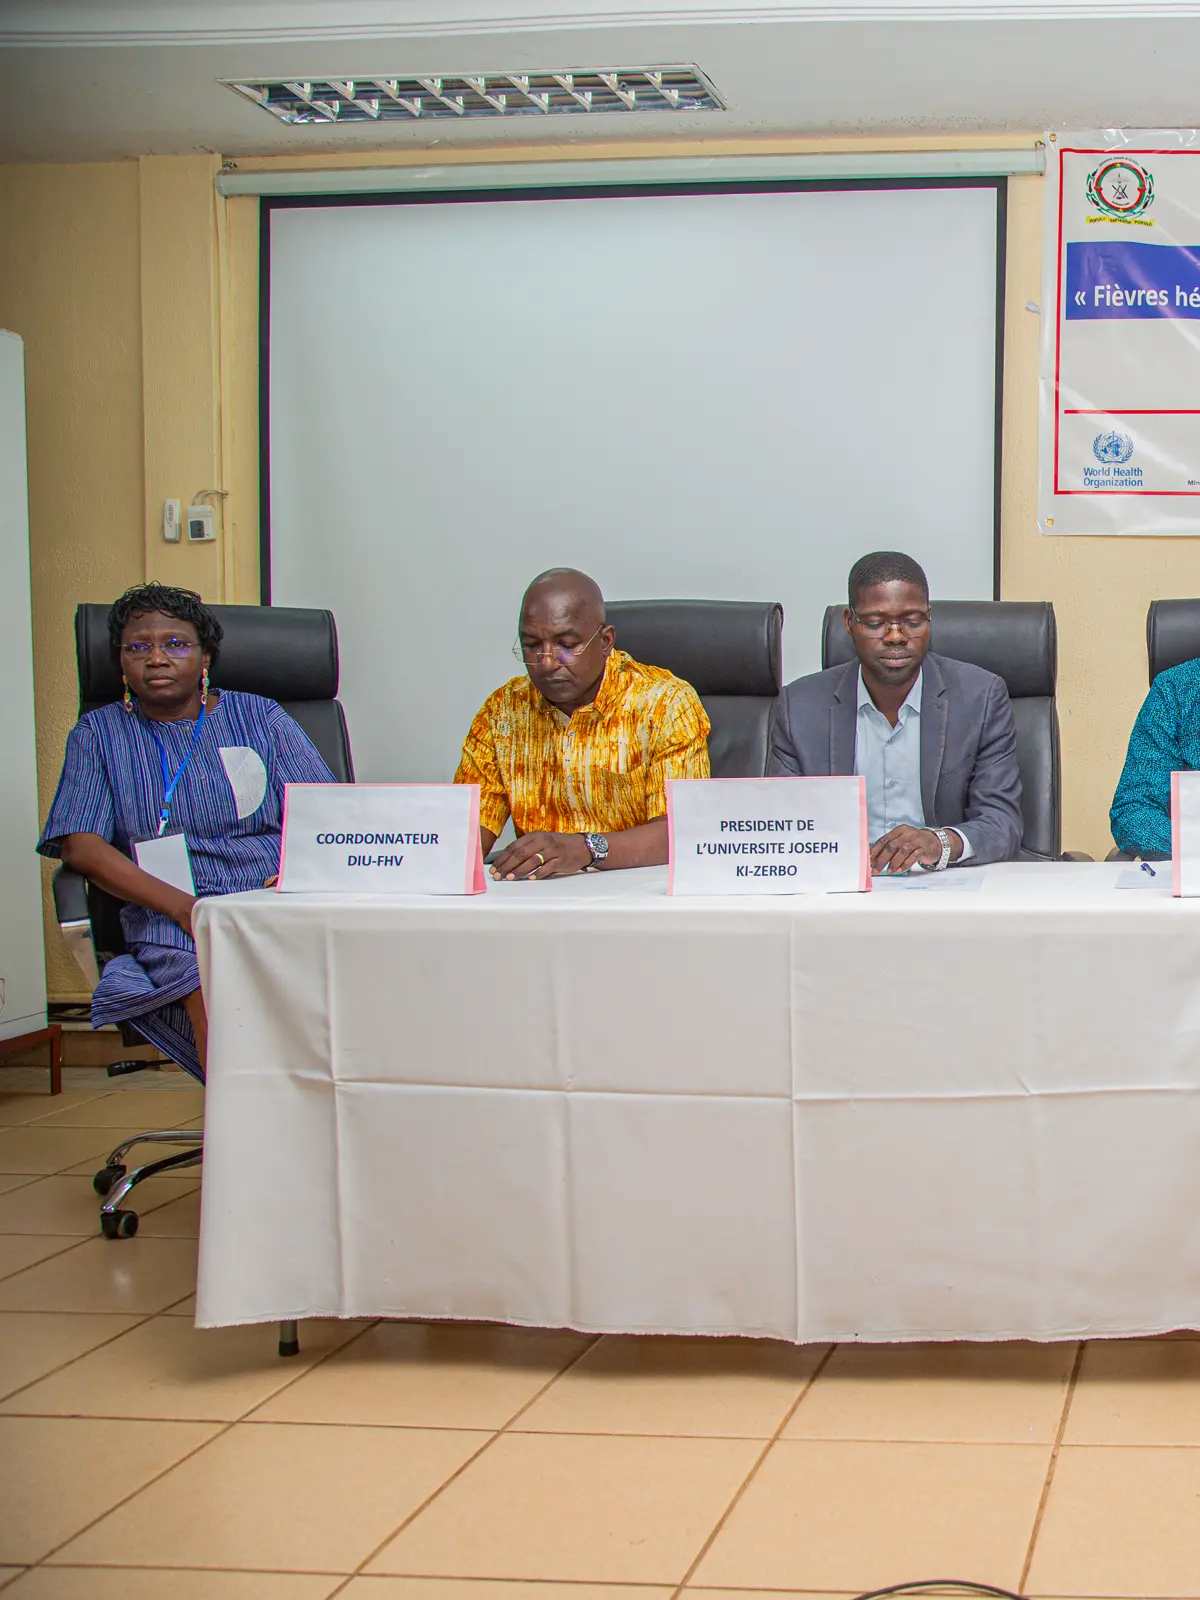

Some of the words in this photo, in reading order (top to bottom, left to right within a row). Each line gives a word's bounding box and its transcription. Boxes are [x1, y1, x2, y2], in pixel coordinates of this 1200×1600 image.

[1094, 284, 1169, 308] Fièvres
[1083, 467, 1111, 477] World
[1113, 467, 1143, 477] Health
[1083, 477, 1143, 489] Organization
[720, 819, 793, 832] PRESIDENT
[797, 819, 815, 831] DE
[316, 833, 439, 845] COORDONNATEUR
[788, 842, 839, 854] JOSEPH
[347, 855, 404, 867] DIU-FHV
[736, 865, 798, 877] KI-ZERBO
